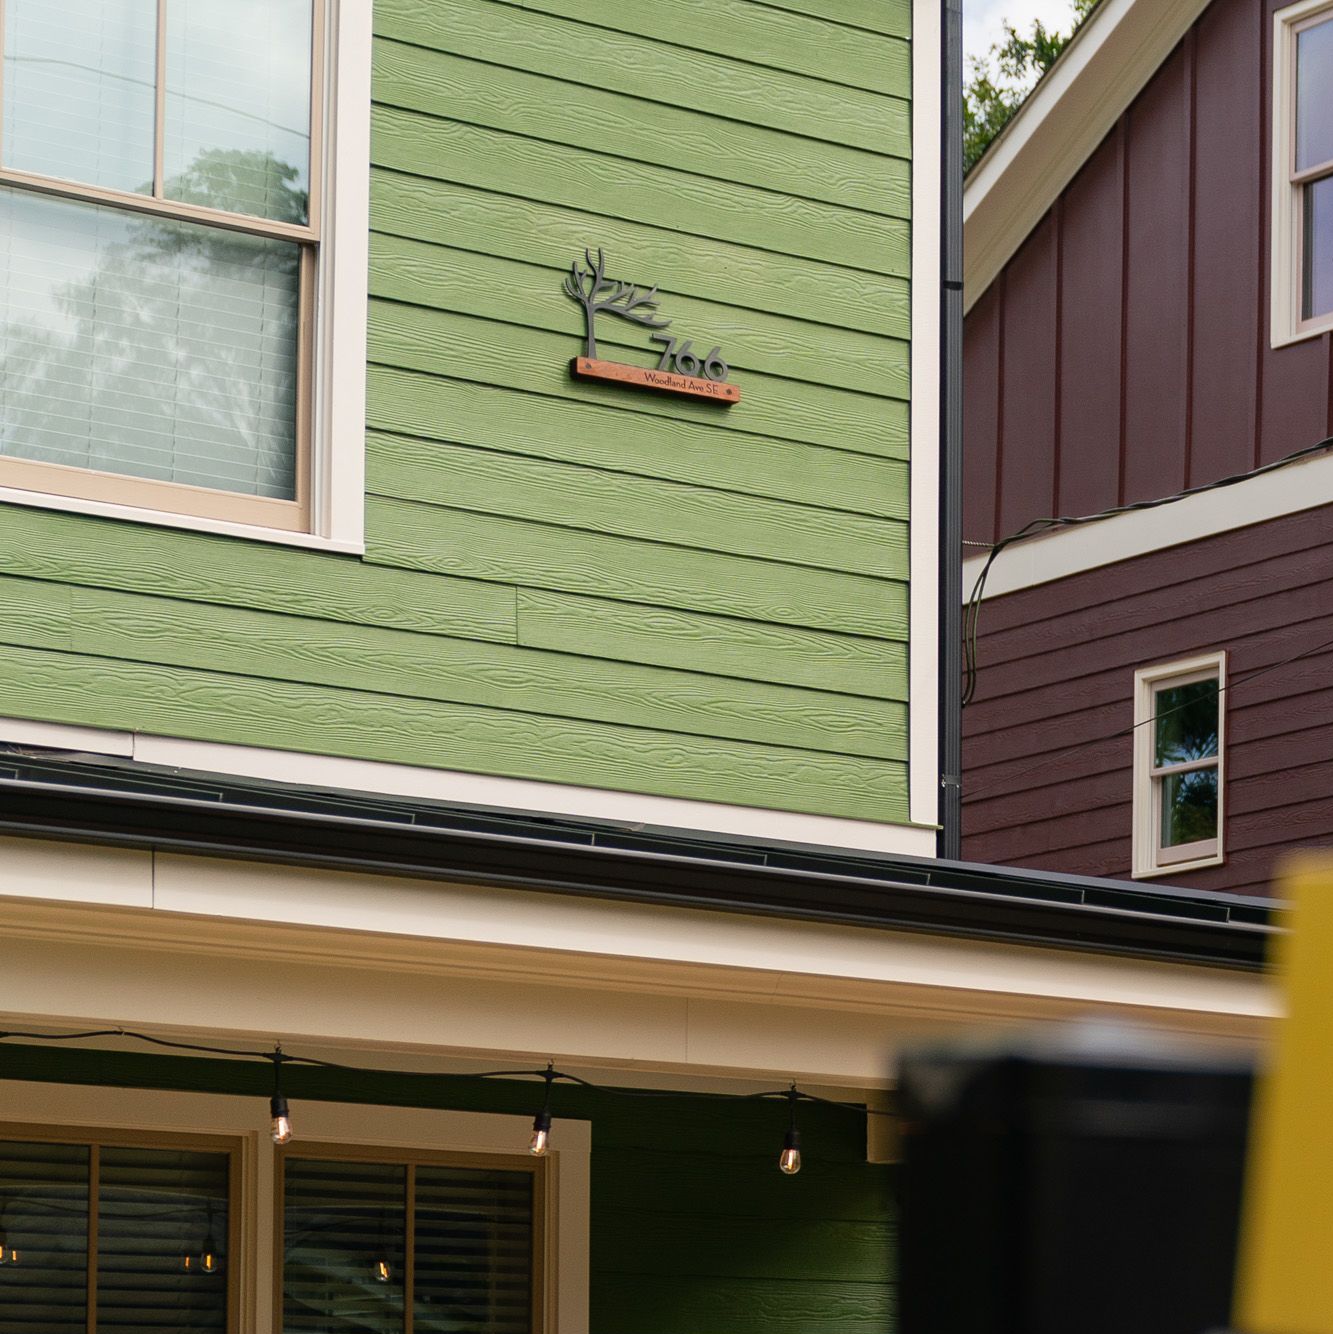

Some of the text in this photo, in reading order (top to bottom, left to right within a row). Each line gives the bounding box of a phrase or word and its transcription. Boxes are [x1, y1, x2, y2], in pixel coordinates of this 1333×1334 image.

[650, 333, 728, 382] 766
[644, 372, 719, 395] Woodland Ave SE
